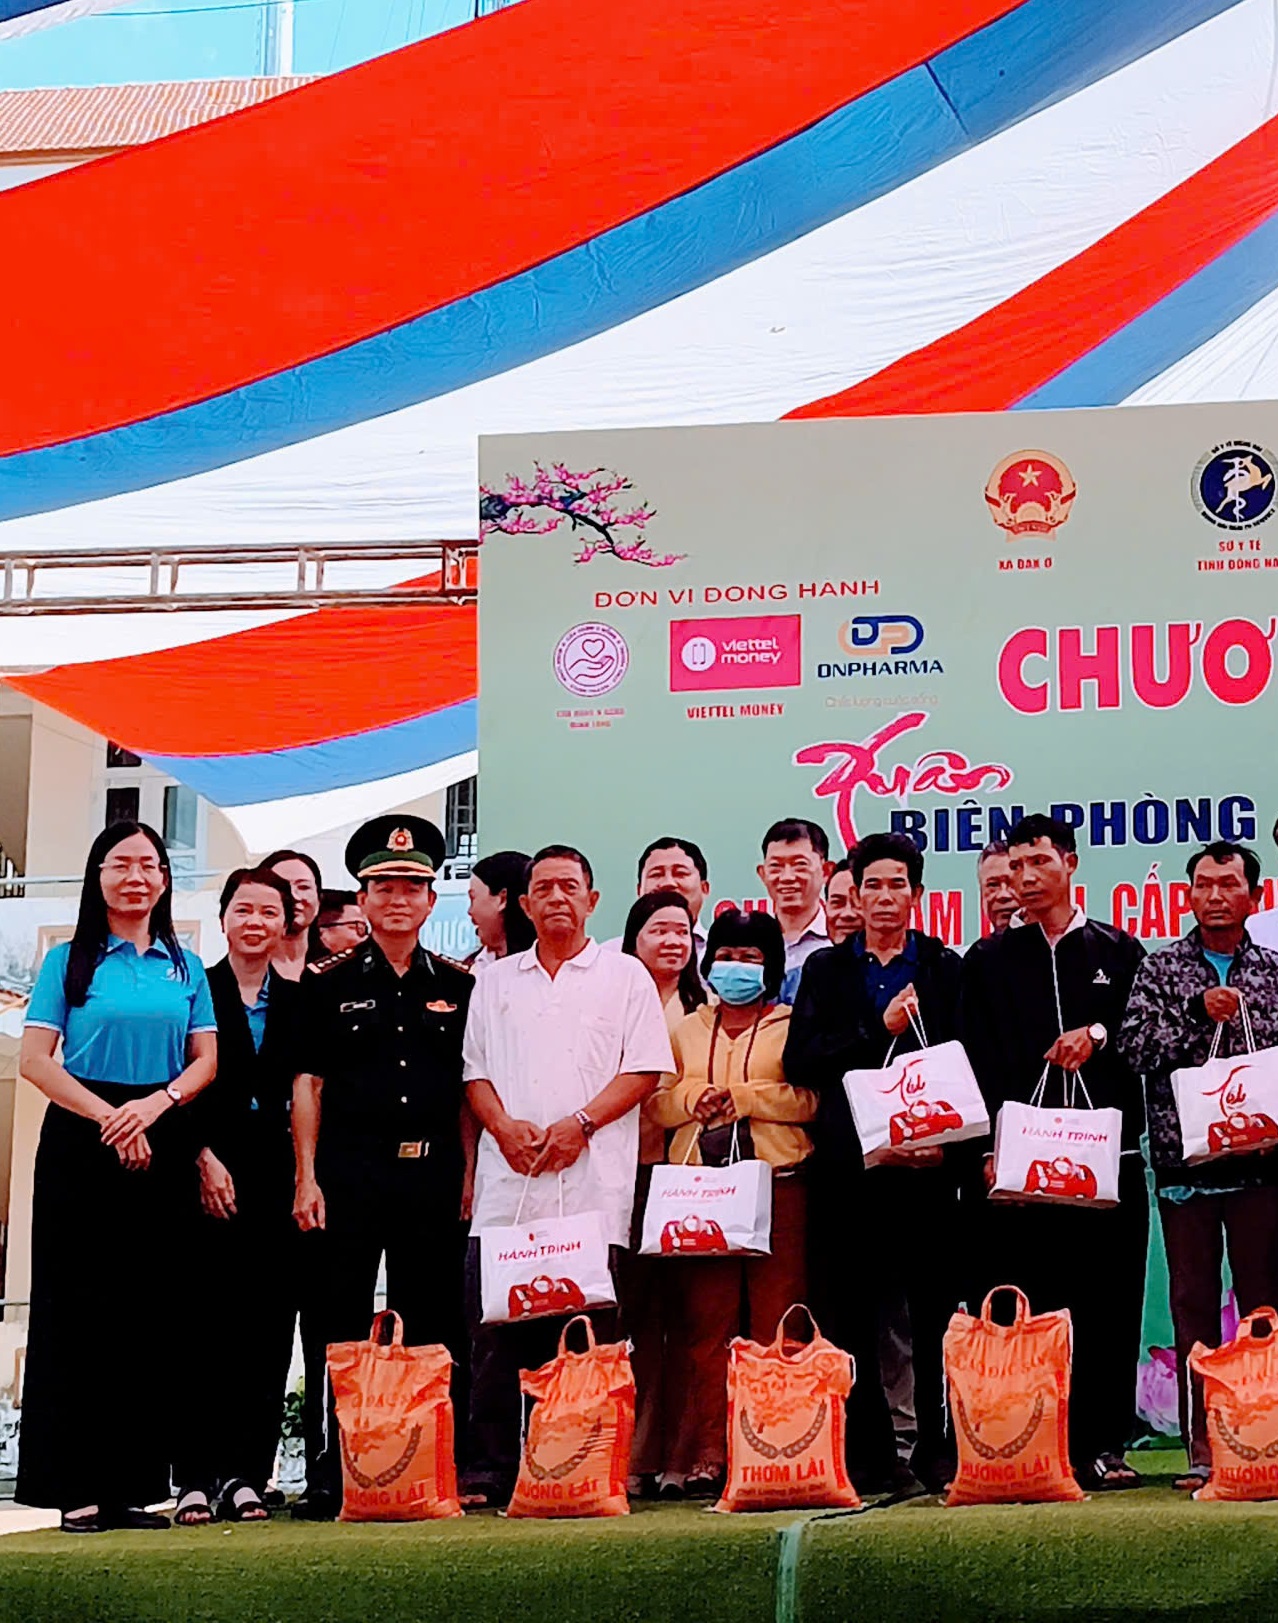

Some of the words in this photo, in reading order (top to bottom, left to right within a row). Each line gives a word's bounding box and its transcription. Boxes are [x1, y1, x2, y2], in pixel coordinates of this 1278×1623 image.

[722, 638, 780, 651] viettel
[721, 650, 782, 664] money
[740, 704, 783, 716] MONEY
[891, 799, 1024, 852] BIÊN
[1050, 794, 1255, 846] PHÒNG
